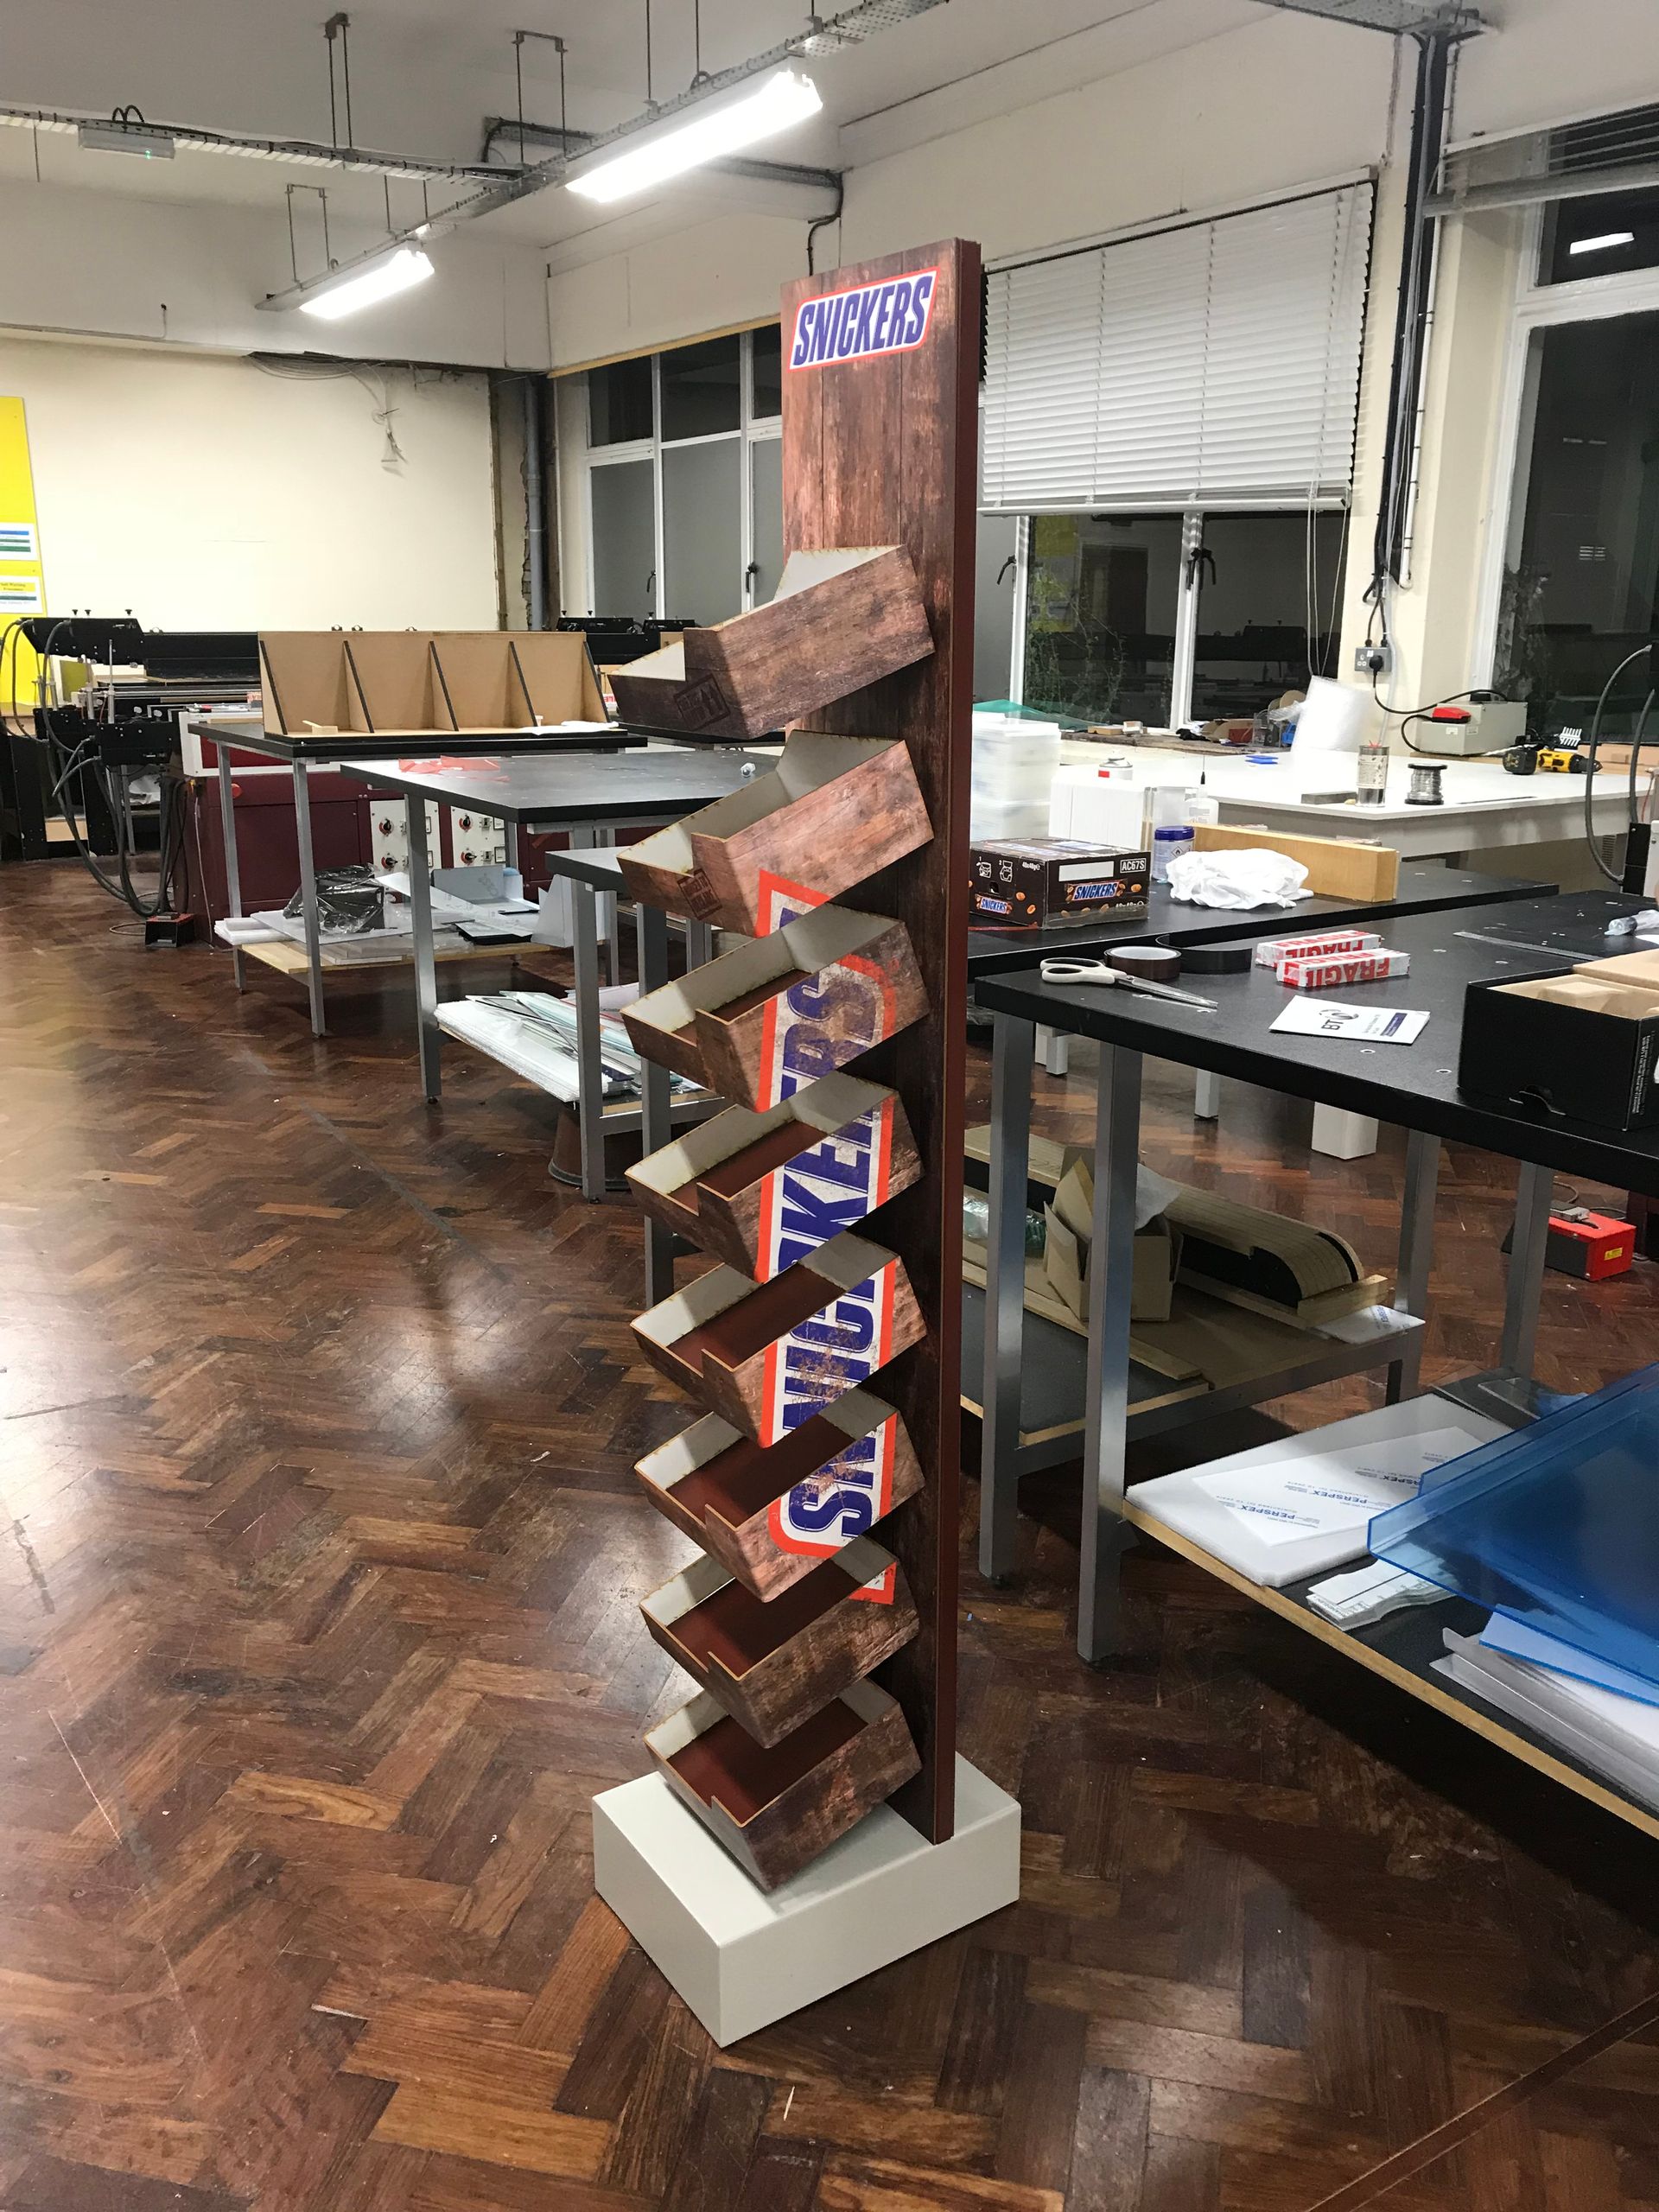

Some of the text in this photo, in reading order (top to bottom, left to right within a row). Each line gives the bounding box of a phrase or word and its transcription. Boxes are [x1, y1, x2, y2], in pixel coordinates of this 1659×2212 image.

[792, 275, 933, 366] SNICKERS
[1121, 859, 1146, 872] AC67S
[1073, 882, 1118, 899] SNICKERS
[981, 897, 1007, 913] SNICKERS
[1320, 1019, 1344, 1031] BT
[1313, 1490, 1368, 1504] PERSPEX
[1240, 1504, 1296, 1520] PERSPEX
